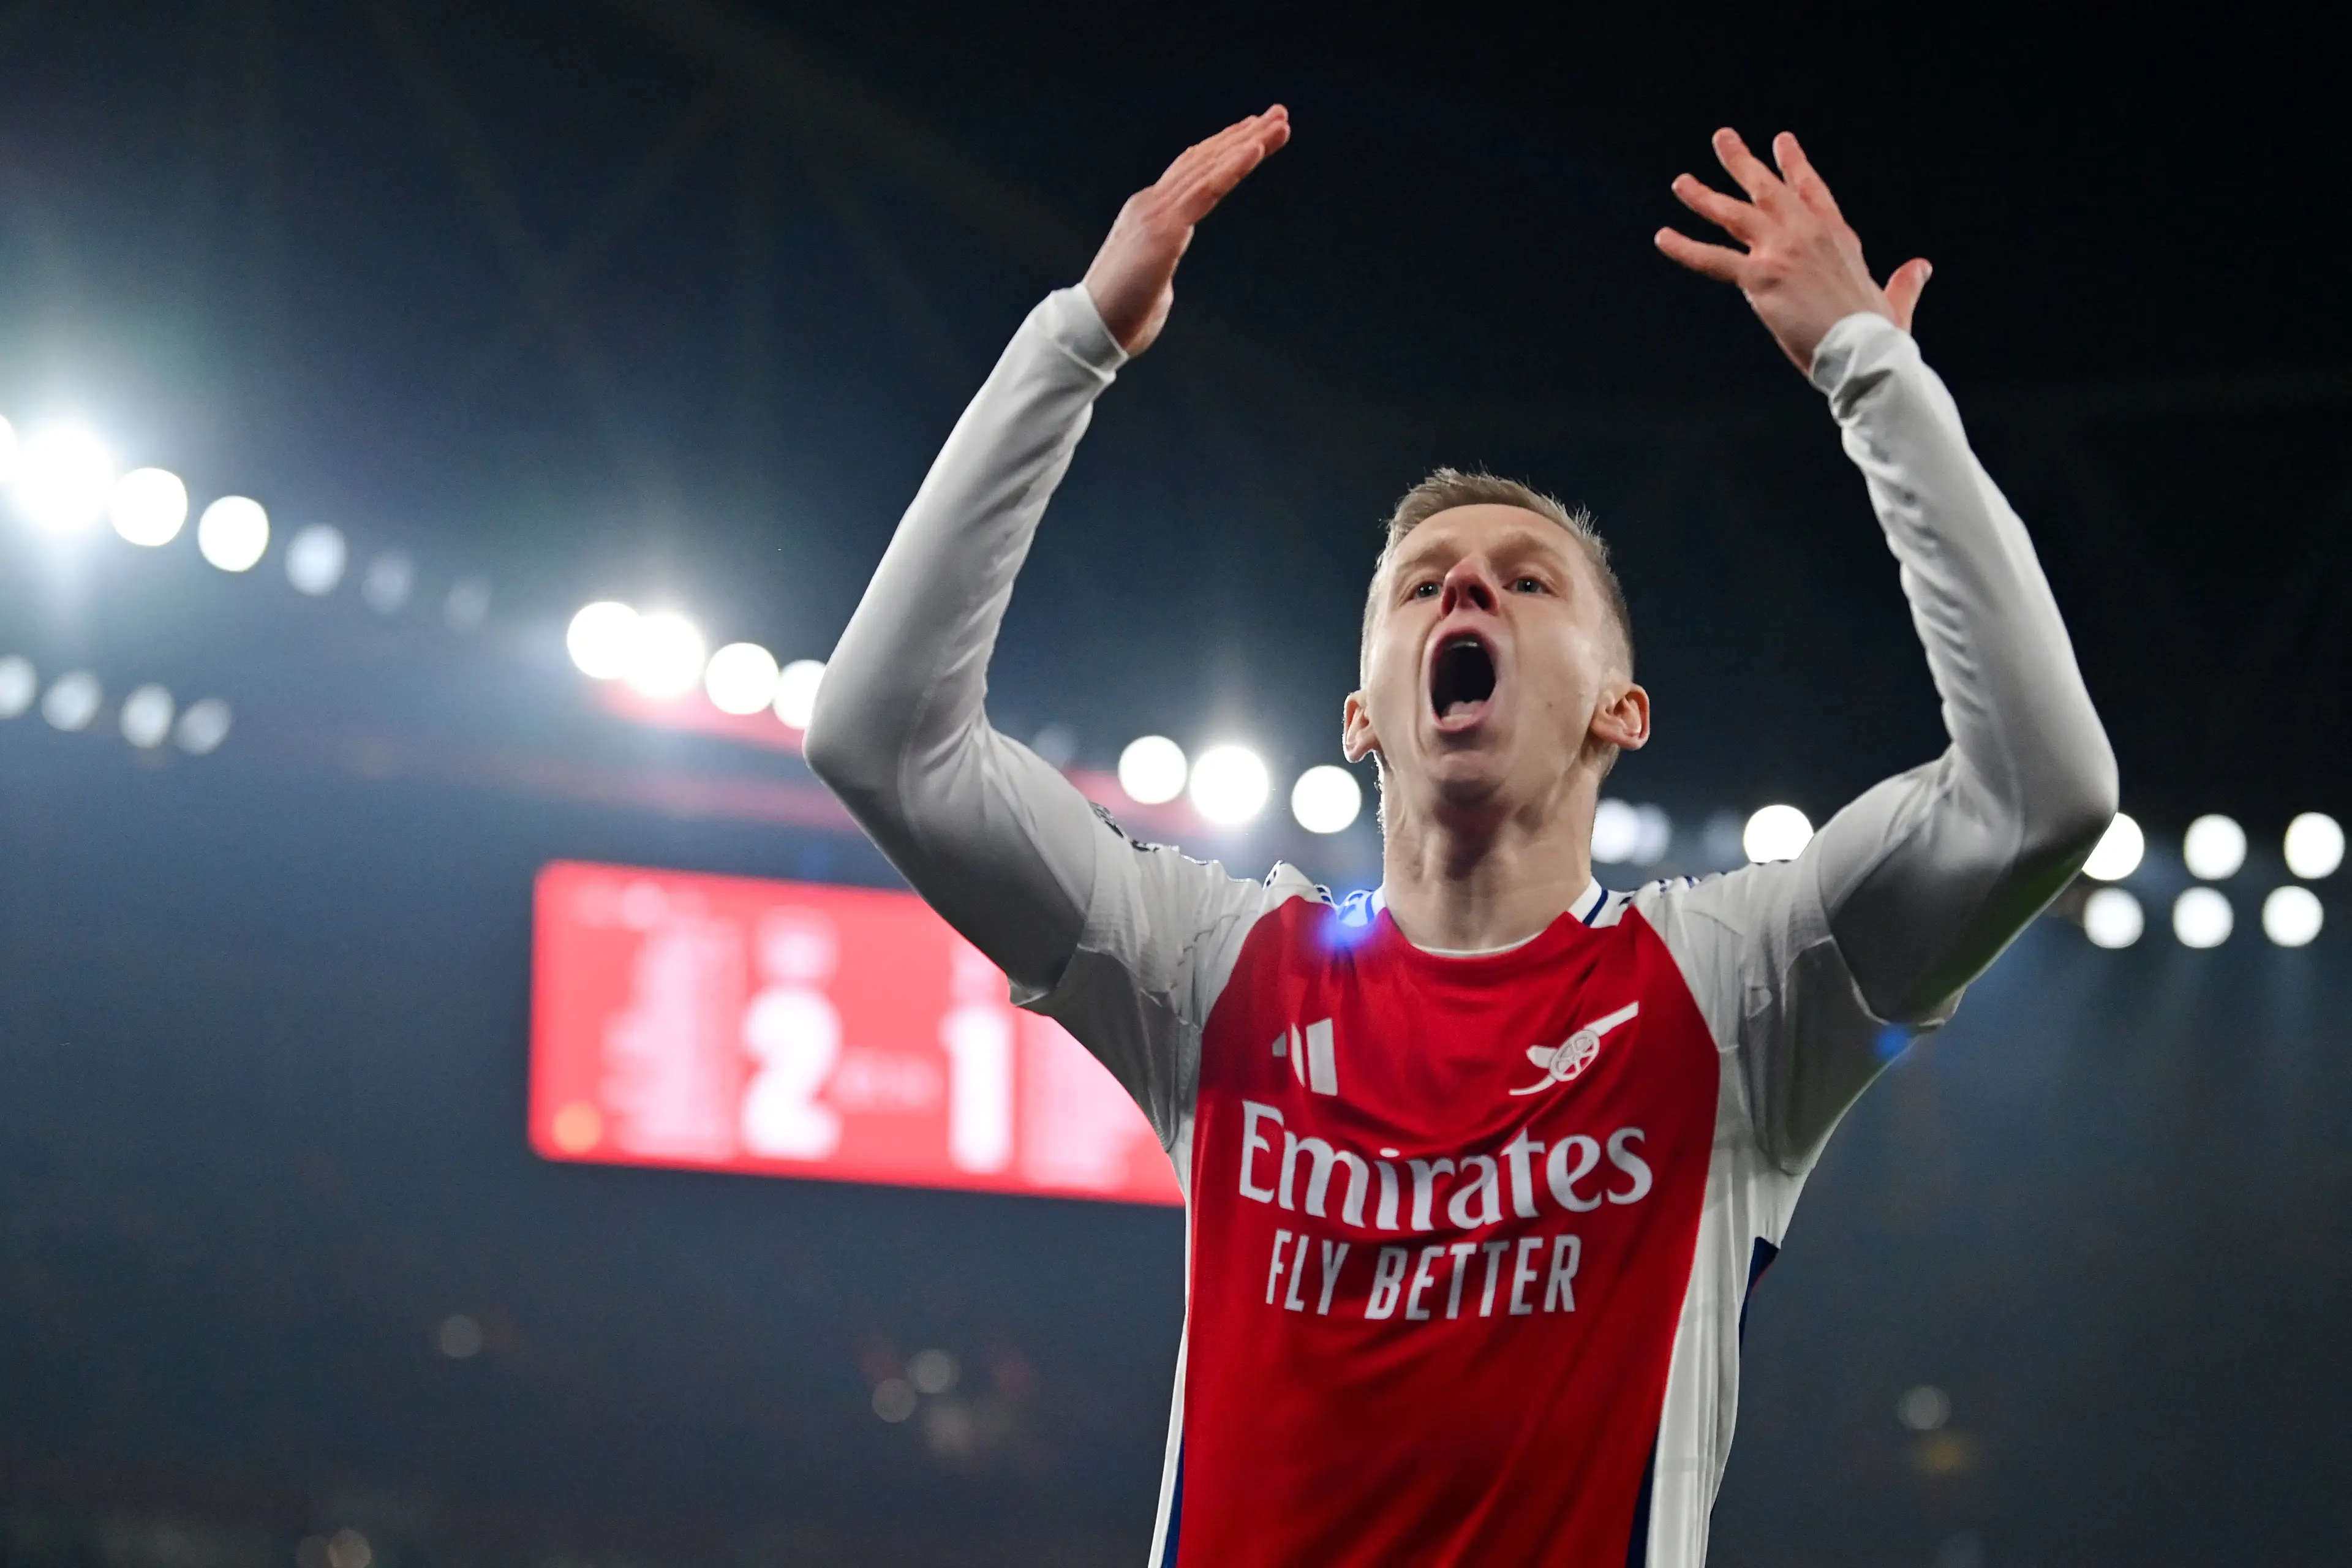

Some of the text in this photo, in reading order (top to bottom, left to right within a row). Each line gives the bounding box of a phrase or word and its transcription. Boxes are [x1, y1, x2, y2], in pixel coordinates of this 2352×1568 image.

[741, 987, 840, 1160] 2
[940, 1006, 1014, 1174] 1
[1239, 1100, 1653, 1231] Emirates
[1265, 1229, 1581, 1321] FLY BETTER
